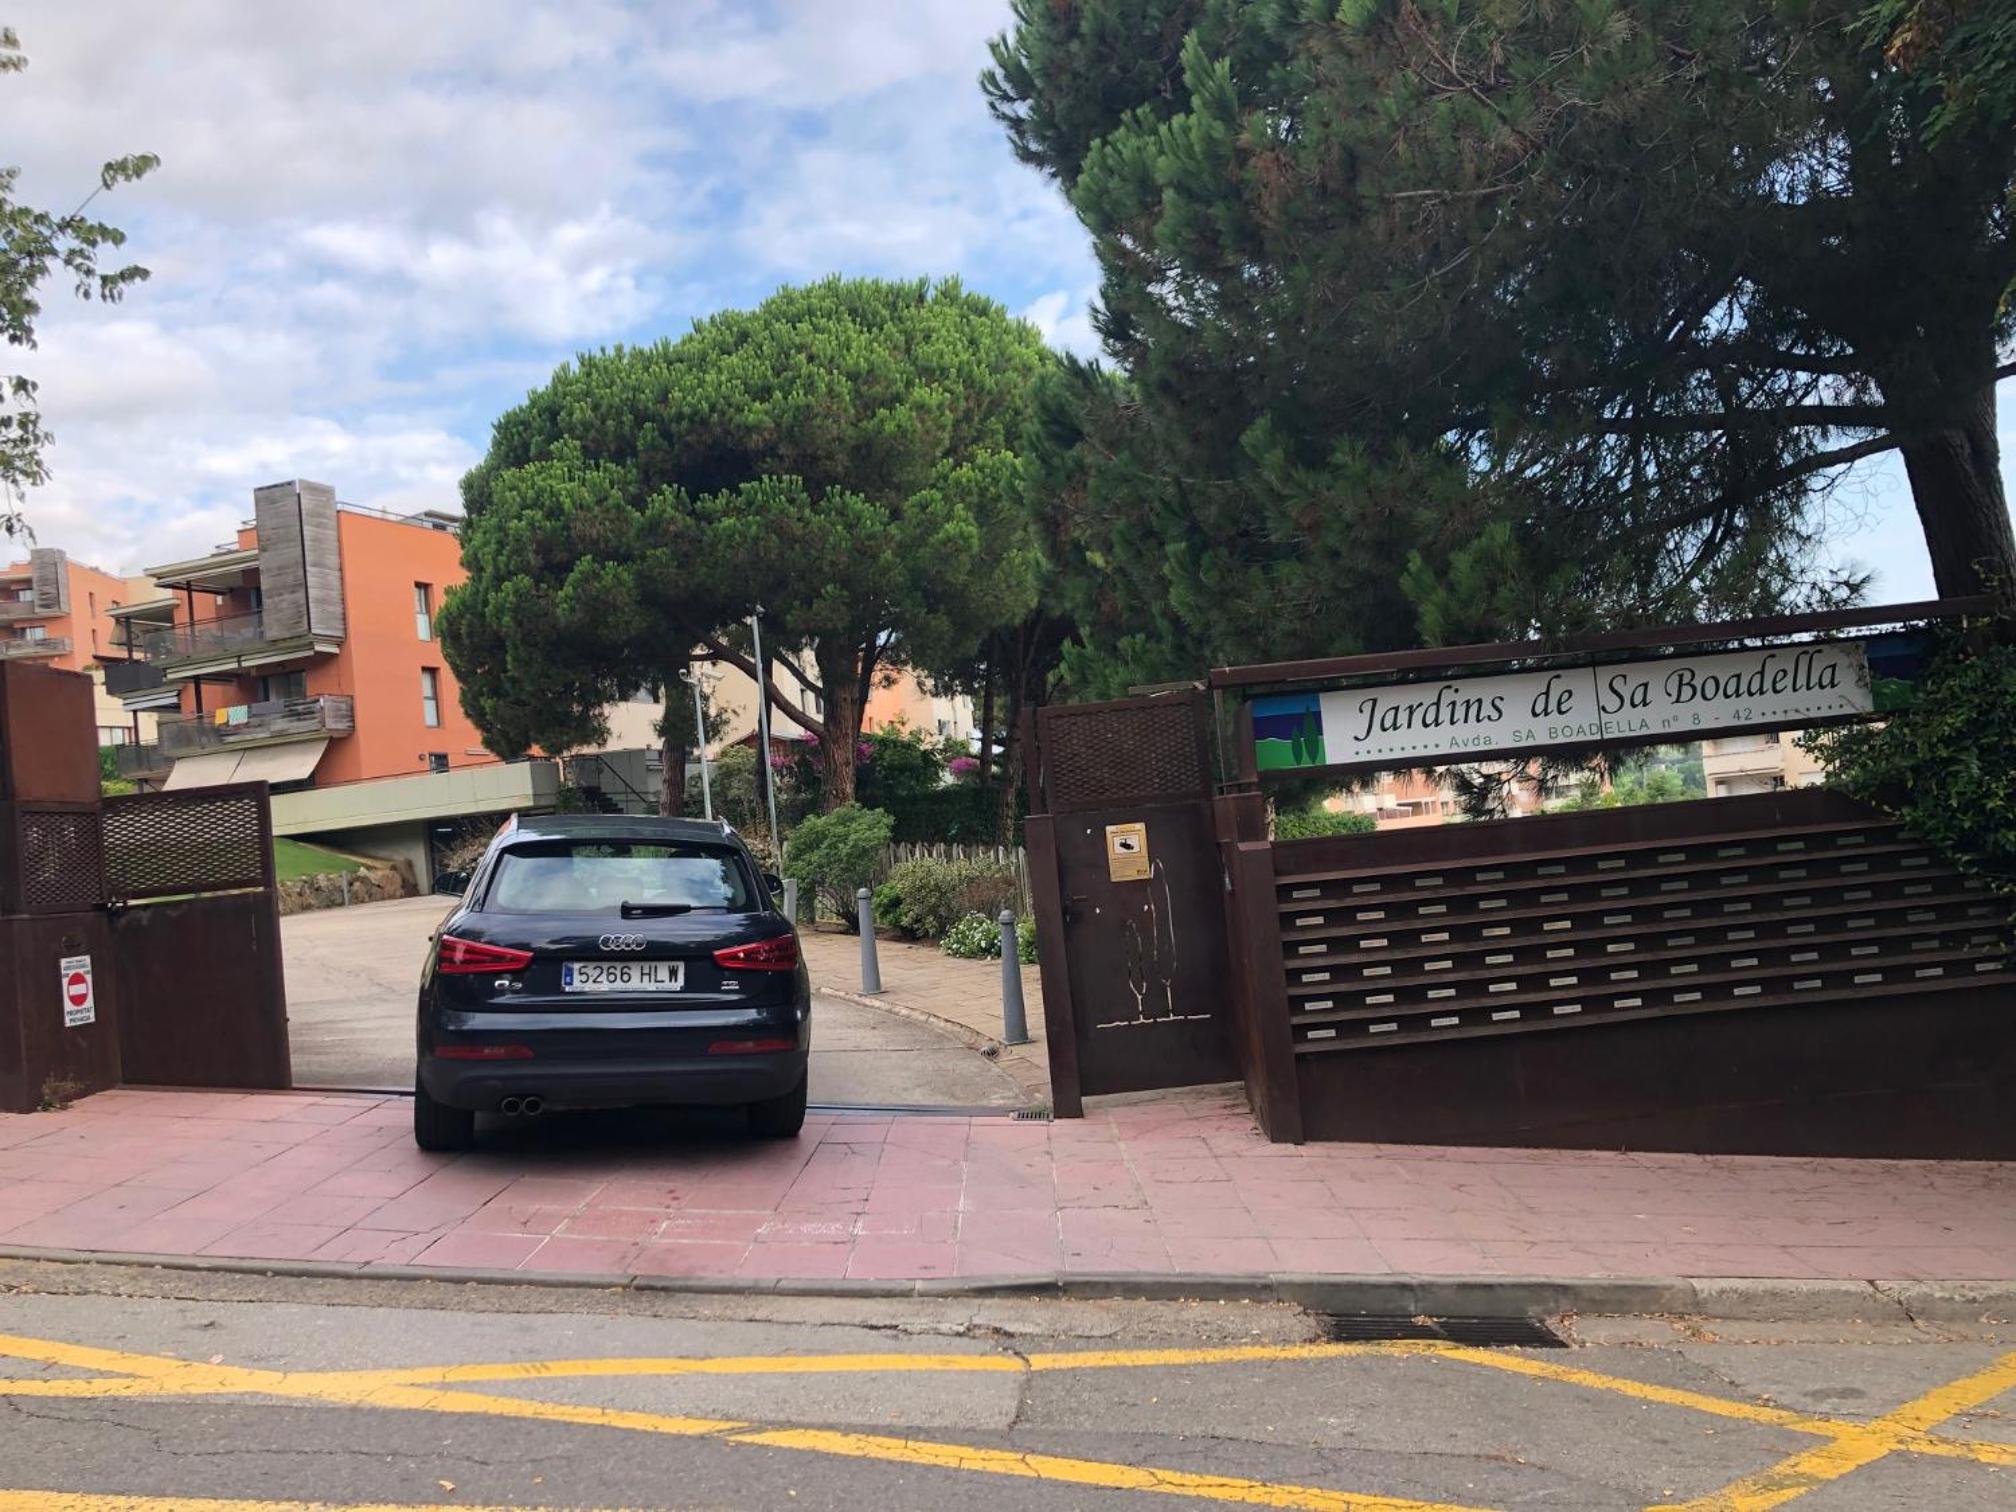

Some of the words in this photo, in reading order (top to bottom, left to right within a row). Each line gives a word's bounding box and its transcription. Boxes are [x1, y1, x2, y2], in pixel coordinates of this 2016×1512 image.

[1353, 685, 1504, 742] Jardins
[1531, 674, 1574, 718] de
[1601, 673, 1652, 714] Sa
[1664, 649, 1841, 704] Boadella
[1449, 735, 1498, 749] Avda.
[1512, 730, 1536, 743] SA
[1549, 718, 1651, 739] BOADELLA
[1692, 713, 1702, 726] 8
[1733, 708, 1753, 721] 42
[578, 965, 632, 983] 5266
[640, 964, 679, 983] HLW
